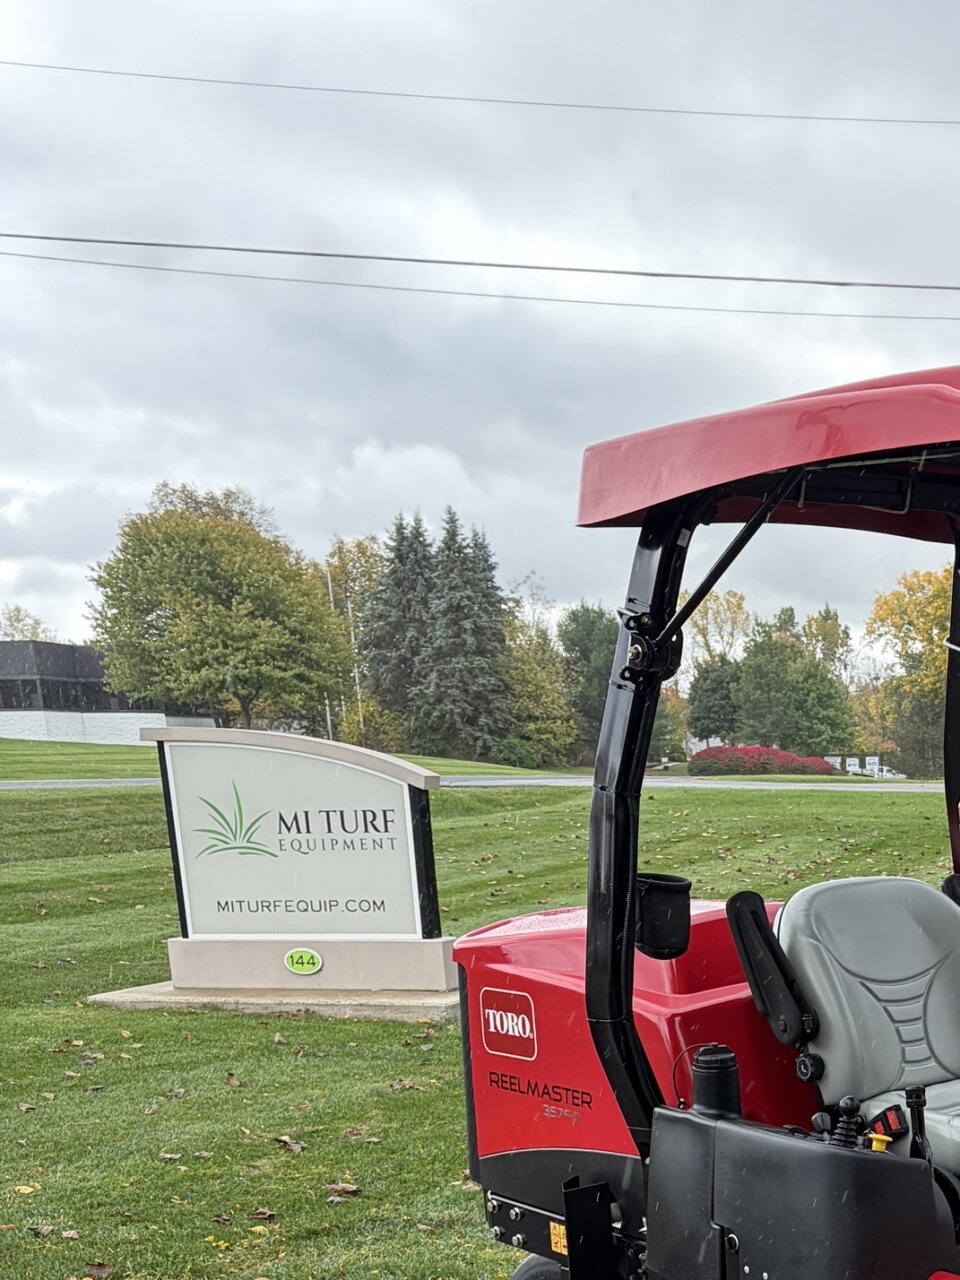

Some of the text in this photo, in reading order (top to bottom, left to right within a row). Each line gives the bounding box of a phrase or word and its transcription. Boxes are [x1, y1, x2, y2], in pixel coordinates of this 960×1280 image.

[277, 809, 396, 834] MI TURF
[279, 837, 397, 854] EQUIPMENT
[217, 900, 386, 913] MITURFEQUIP.COM
[289, 955, 317, 967] 144
[485, 1009, 532, 1039] TORO
[489, 1071, 592, 1110] REELMASTER
